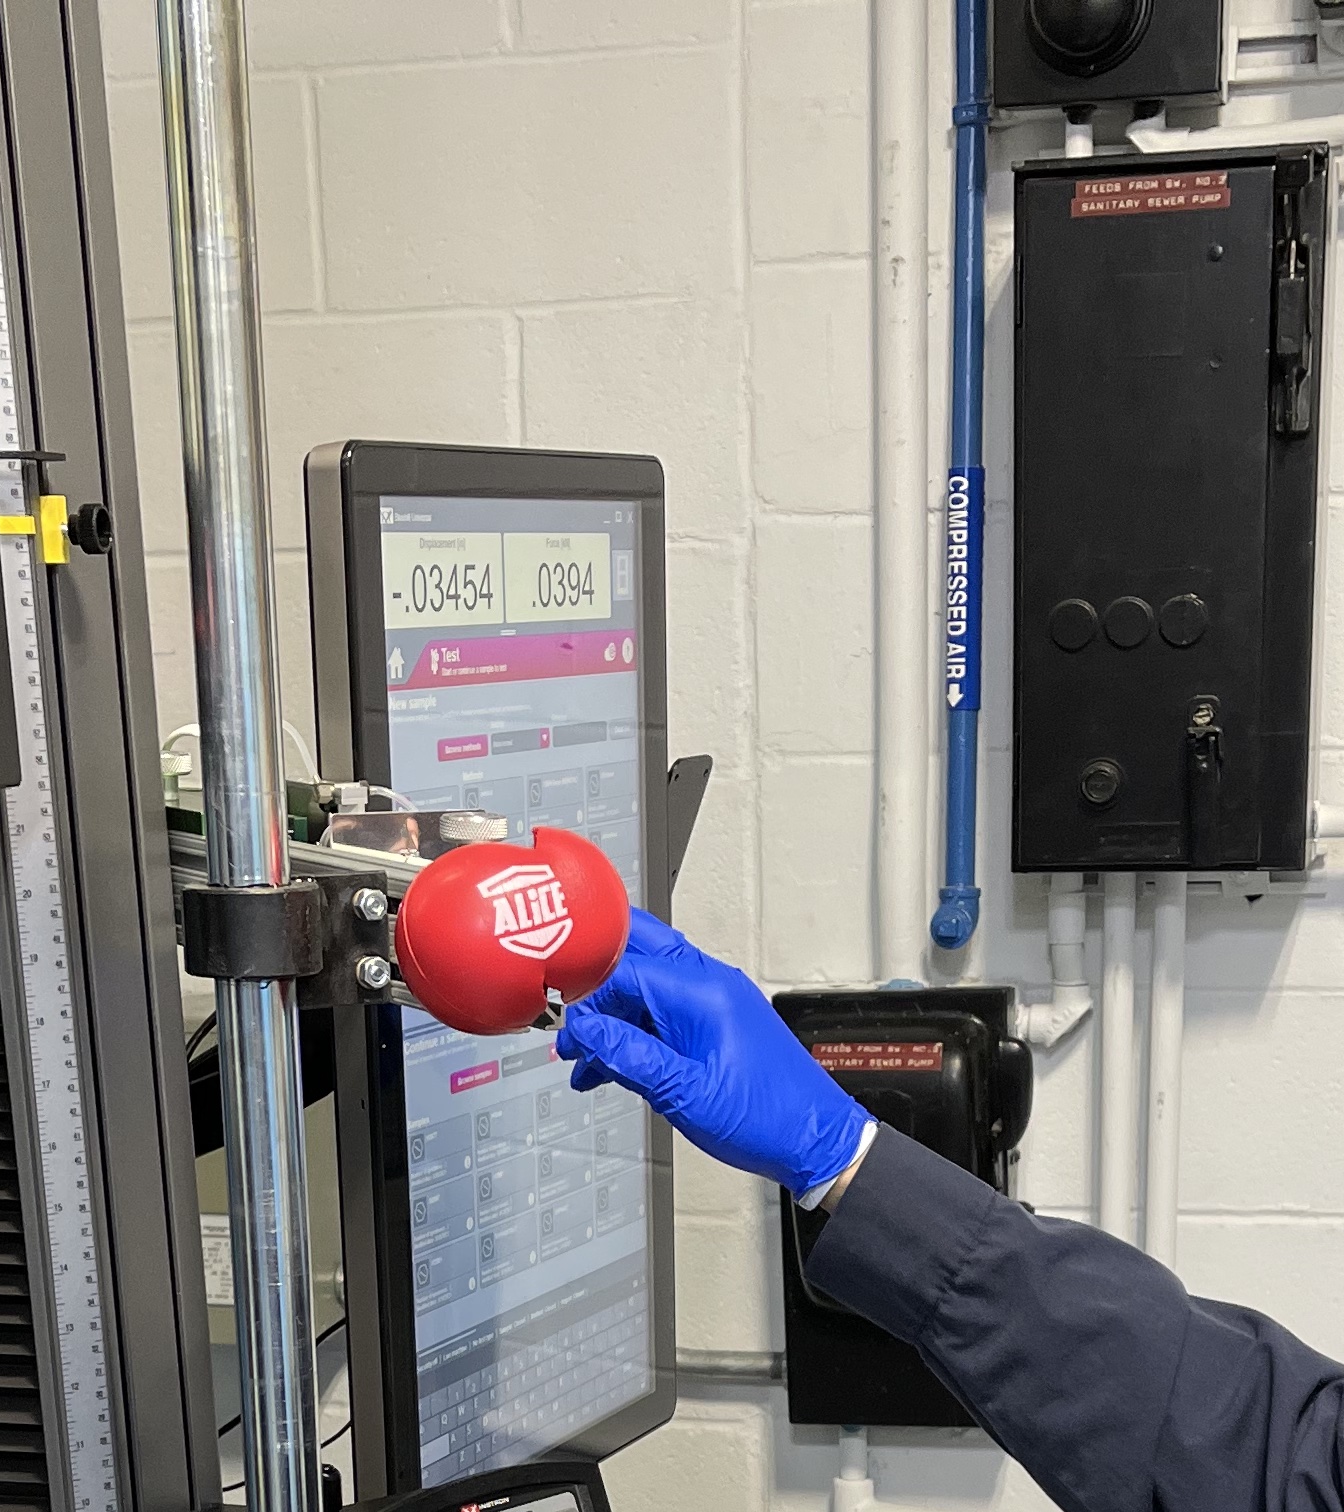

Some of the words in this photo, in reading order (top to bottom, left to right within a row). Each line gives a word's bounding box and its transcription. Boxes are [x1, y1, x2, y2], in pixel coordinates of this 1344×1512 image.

[1084, 182, 1122, 194] FEEDS
[1128, 179, 1159, 191] FROM
[1081, 199, 1140, 212] SANITARY
[1147, 195, 1185, 207] SEWER
[1192, 193, 1221, 204] PUMP
[419, 538, 456, 551] Displacement
[947, 476, 969, 636] COMPRESSED
[392, 563, 493, 613] -.03454
[532, 561, 594, 608] .0394
[441, 648, 461, 663] Test
[946, 641, 966, 679] AIR
[409, 695, 437, 709] sample
[16, 824, 25, 833] 21
[23, 890, 32, 898] 20
[869, 1058, 902, 1067] SEWER
[907, 1059, 934, 1067] PUMP
[42, 1080, 50, 1088] 17
[48, 1142, 56, 1150] 16
[55, 1204, 62, 1212] 15
